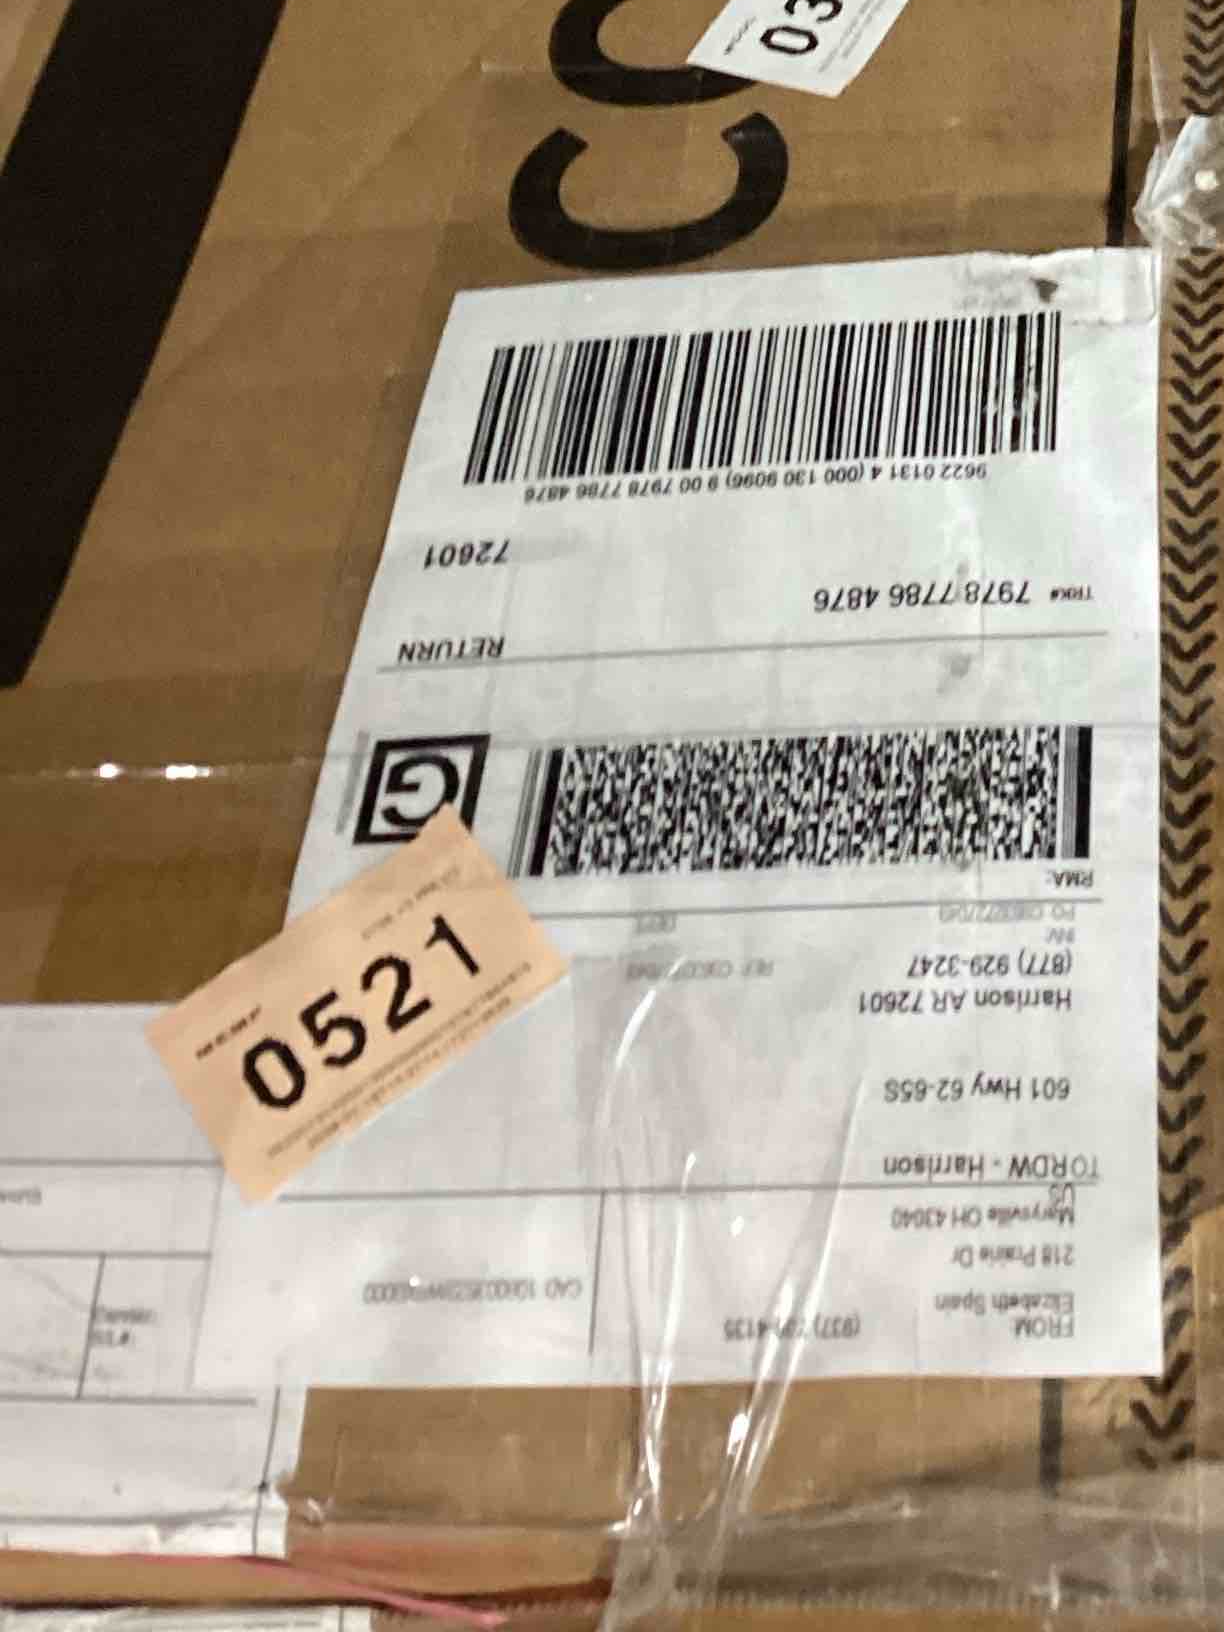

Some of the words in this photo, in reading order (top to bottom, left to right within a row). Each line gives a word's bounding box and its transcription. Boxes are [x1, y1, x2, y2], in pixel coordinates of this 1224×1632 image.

[870, 466, 883, 481] 4
[940, 462, 987, 480] 9622
[422, 539, 512, 568] 72601
[813, 585, 881, 613] 4876
[888, 582, 956, 610] 7786
[963, 580, 1031, 606] 7978
[397, 636, 506, 663] RETURN
[907, 954, 1010, 978] 929-3247
[1018, 948, 1072, 975] (877)
[857, 991, 924, 1015] 72601
[931, 990, 968, 1014] AR
[974, 989, 1072, 1011] Harrison
[240, 911, 484, 1114] 0521
[883, 1078, 964, 1102] 62-65S
[972, 1072, 1021, 1101] Hwy
[1030, 1078, 1071, 1101] 601
[882, 1155, 985, 1180] Harrison
[951, 1207, 981, 1228] OH
[988, 1196, 1075, 1226] Marysville
[951, 1246, 973, 1268] Dr
